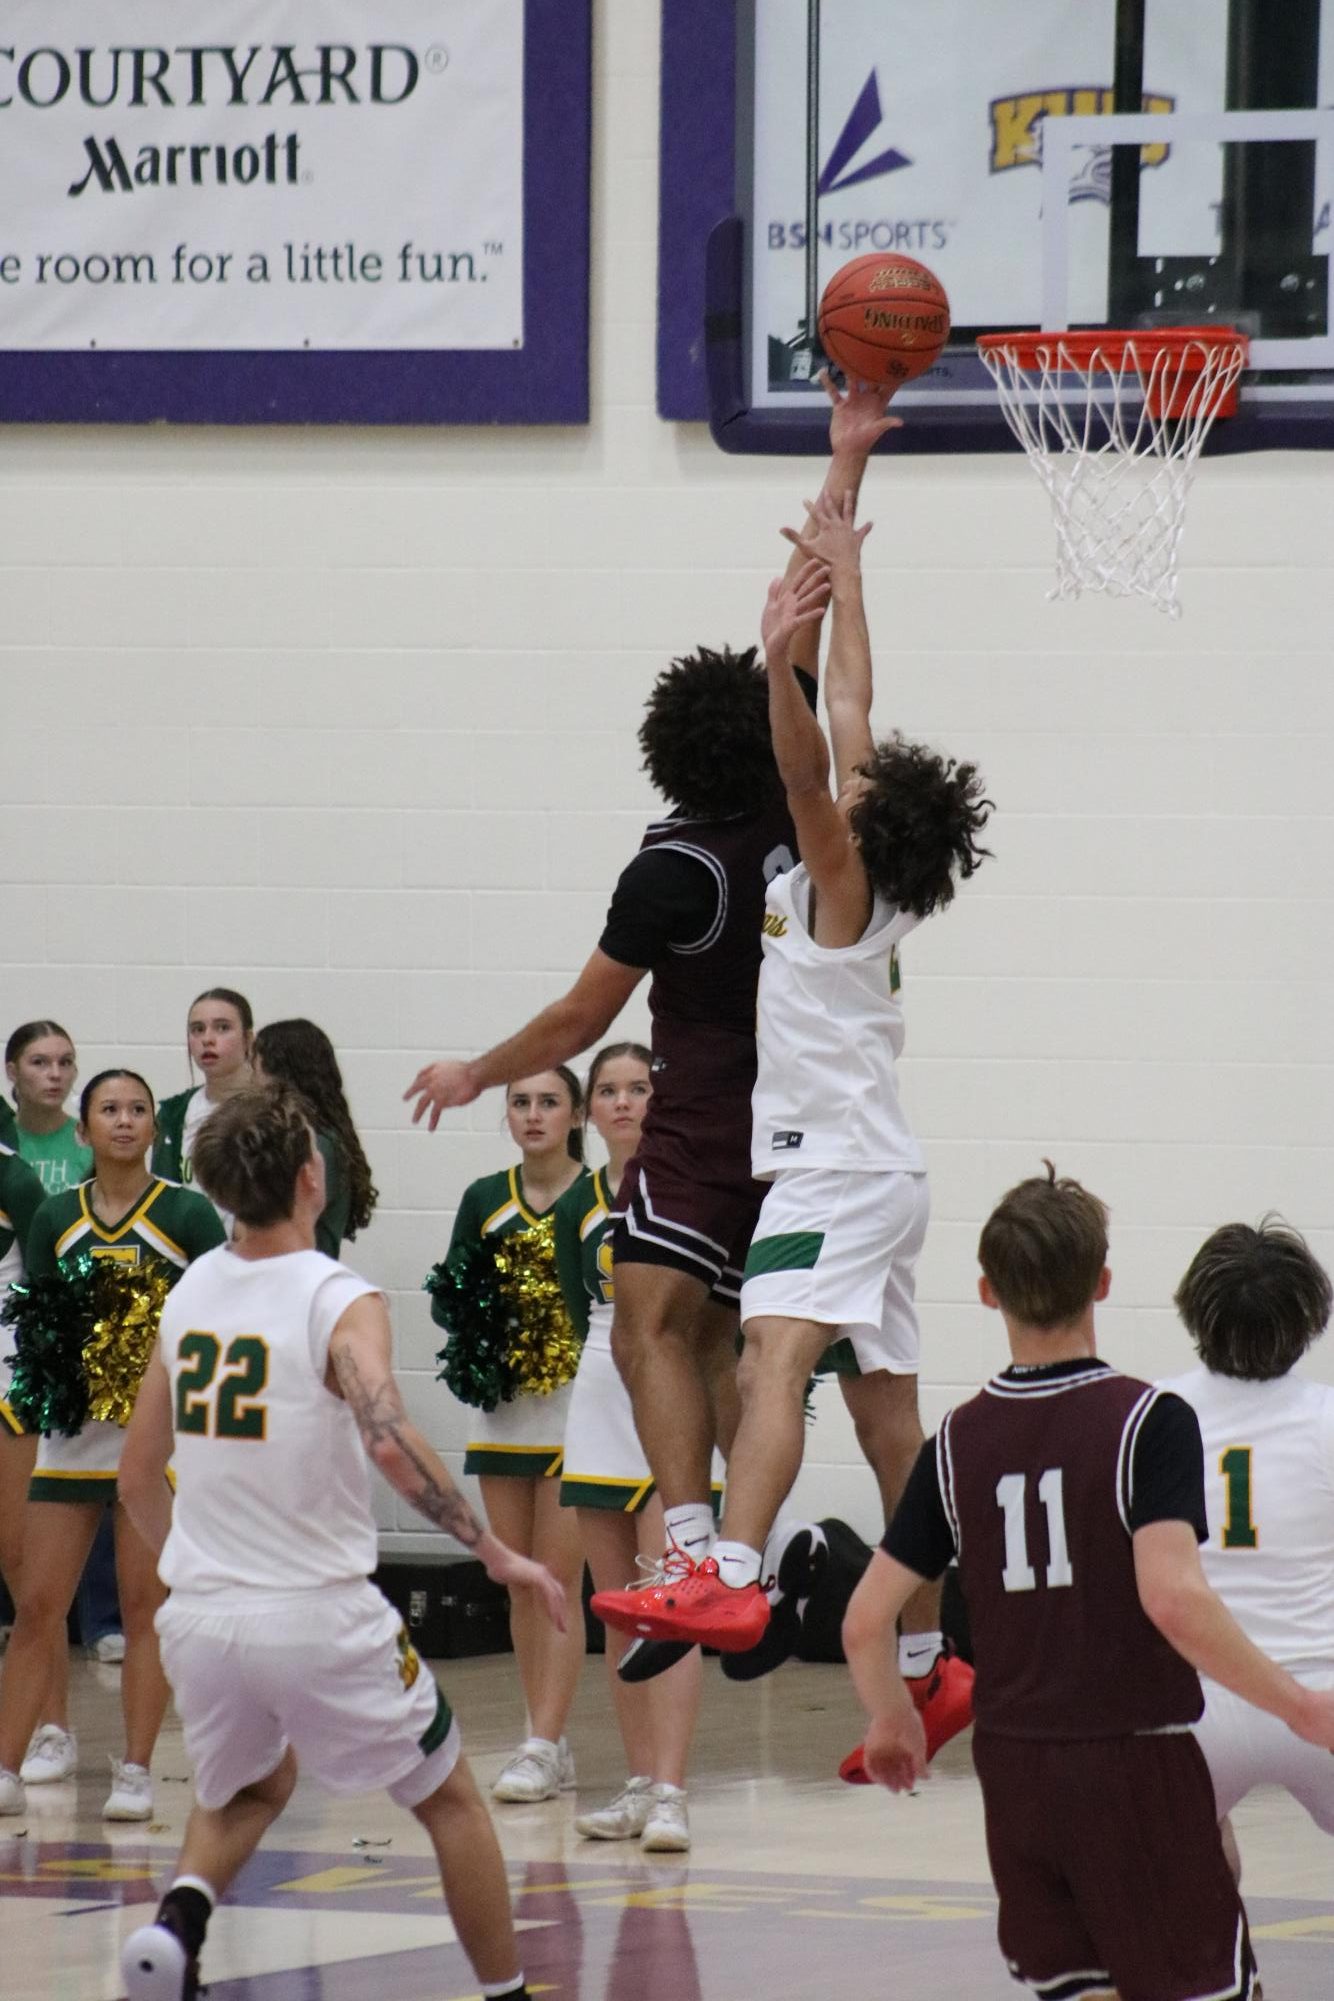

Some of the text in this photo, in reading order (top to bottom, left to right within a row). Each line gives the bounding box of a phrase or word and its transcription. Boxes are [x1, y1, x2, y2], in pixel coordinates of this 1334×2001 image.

[67, 131, 301, 198] Marriott
[36, 254, 157, 284] room
[171, 242, 233, 284] for
[246, 254, 271, 284] a
[284, 242, 383, 284] little
[839, 221, 947, 250] SPORTS
[176, 1330, 270, 1441] 22
[996, 1467, 1073, 1592] 11
[1218, 1446, 1258, 1550] 1
